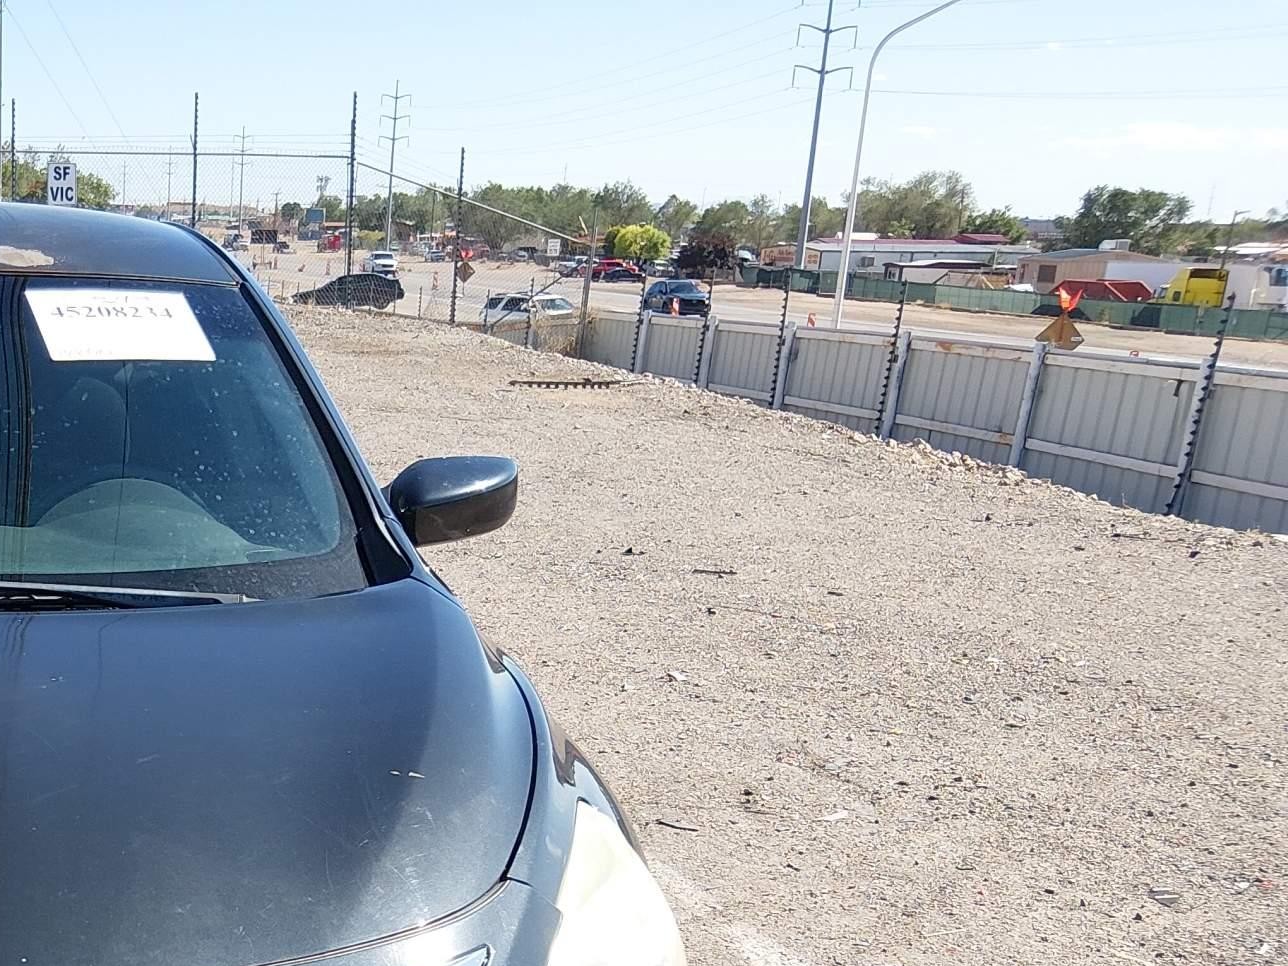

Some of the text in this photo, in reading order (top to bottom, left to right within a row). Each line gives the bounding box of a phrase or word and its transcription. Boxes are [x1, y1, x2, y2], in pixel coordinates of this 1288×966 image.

[53, 166, 70, 181] SF
[50, 186, 74, 202] VIC
[50, 306, 174, 319] 45208234
